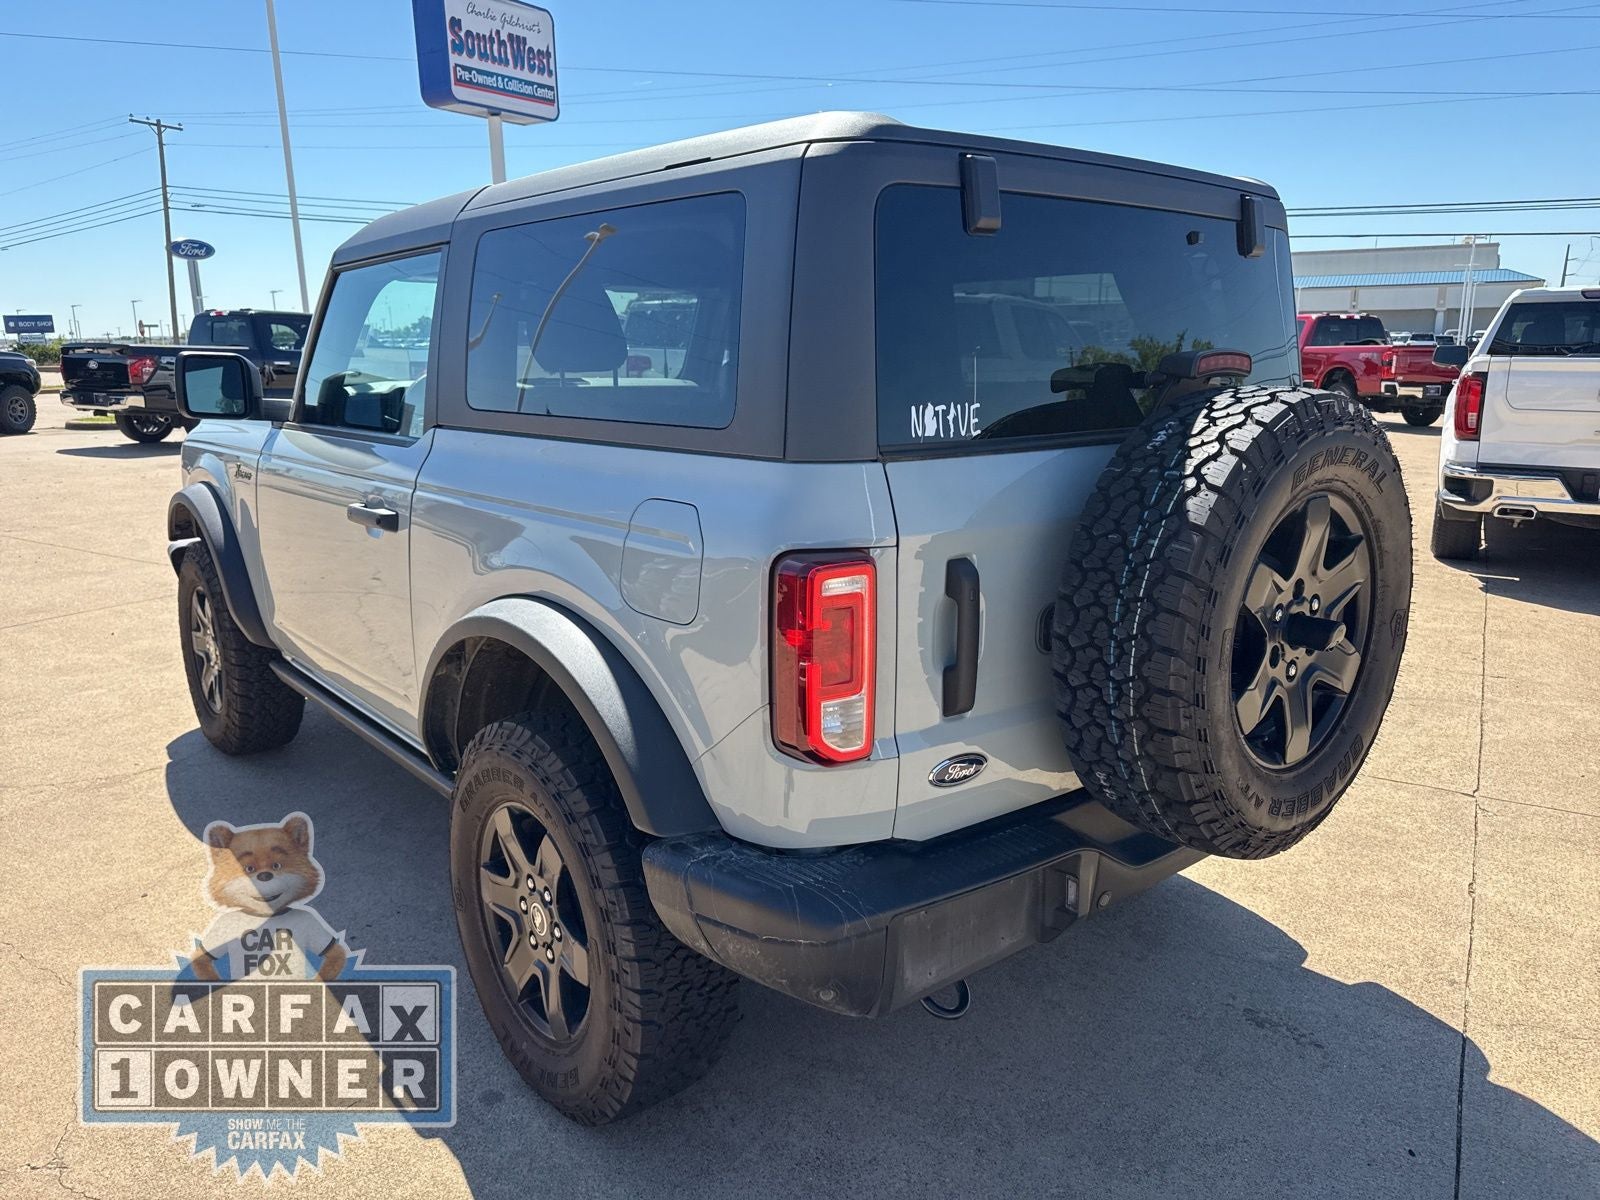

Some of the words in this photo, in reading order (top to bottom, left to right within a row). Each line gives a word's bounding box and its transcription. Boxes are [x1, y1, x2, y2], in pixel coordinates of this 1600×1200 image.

[449, 16, 554, 79] SouthWest
[456, 66, 497, 87] Pre-Owned
[497, 77, 503, 87] &
[504, 78, 534, 95] Collision
[534, 84, 555, 100] Center
[179, 242, 207, 256] Ford
[1291, 445, 1388, 495] GENERAL
[945, 763, 976, 781] Ford
[1268, 734, 1364, 818] GRABBER
